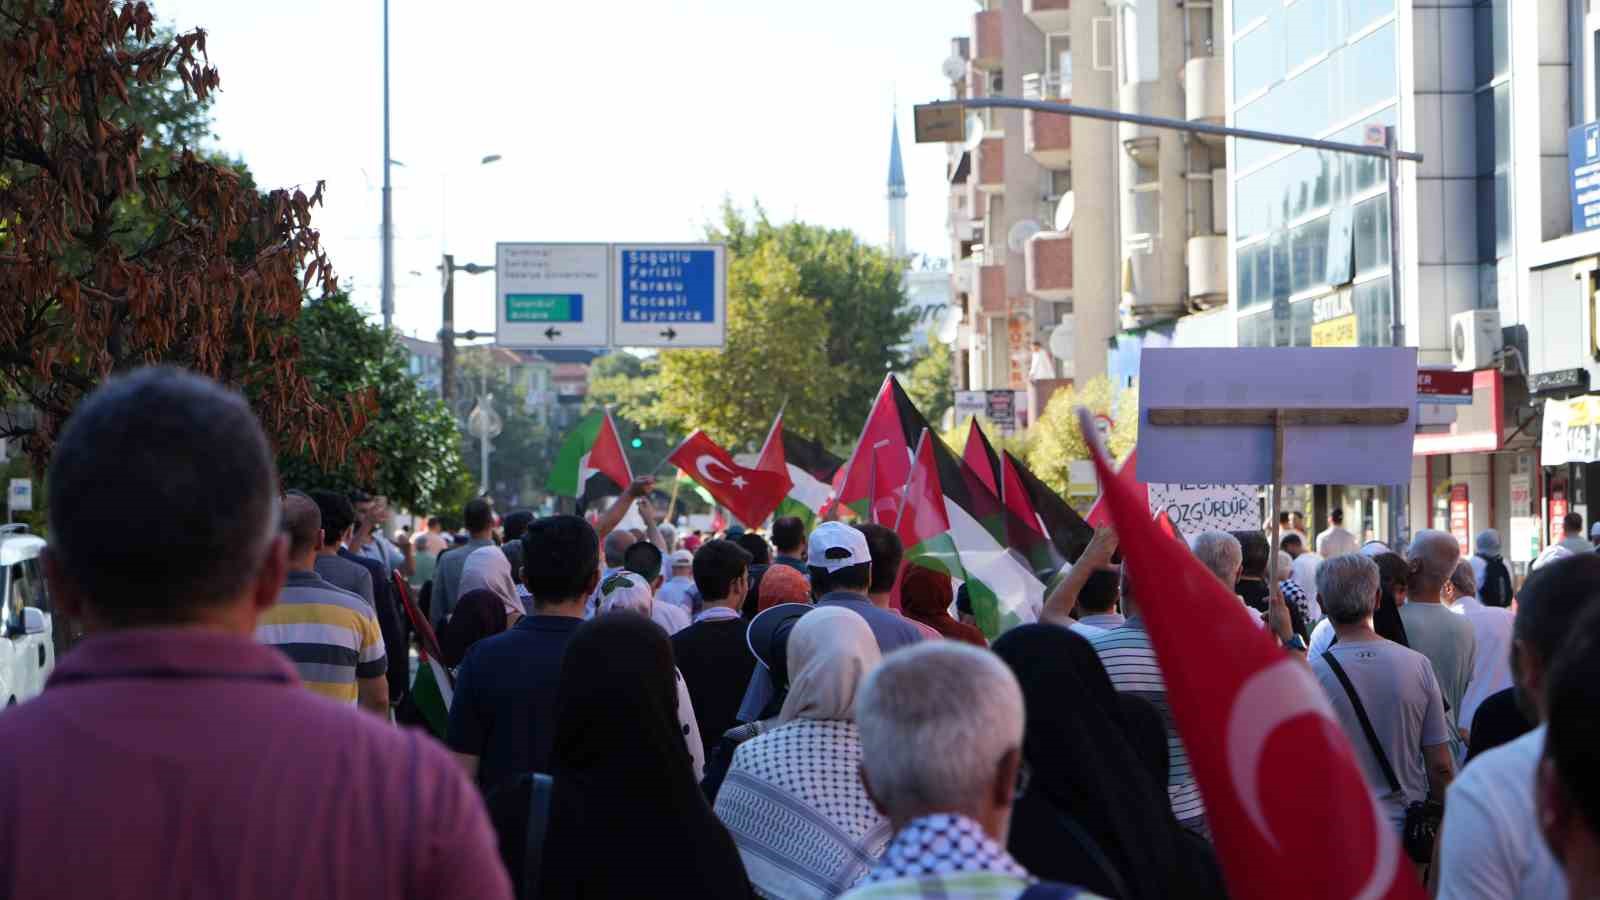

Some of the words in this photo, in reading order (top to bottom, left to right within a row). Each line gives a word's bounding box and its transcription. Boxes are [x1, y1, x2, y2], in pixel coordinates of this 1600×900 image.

[629, 279, 684, 292] Karasu
[629, 295, 688, 307] Kocaali
[629, 308, 702, 322] Kaynarca
[1166, 495, 1248, 524] ÖZGÜRDÜR
